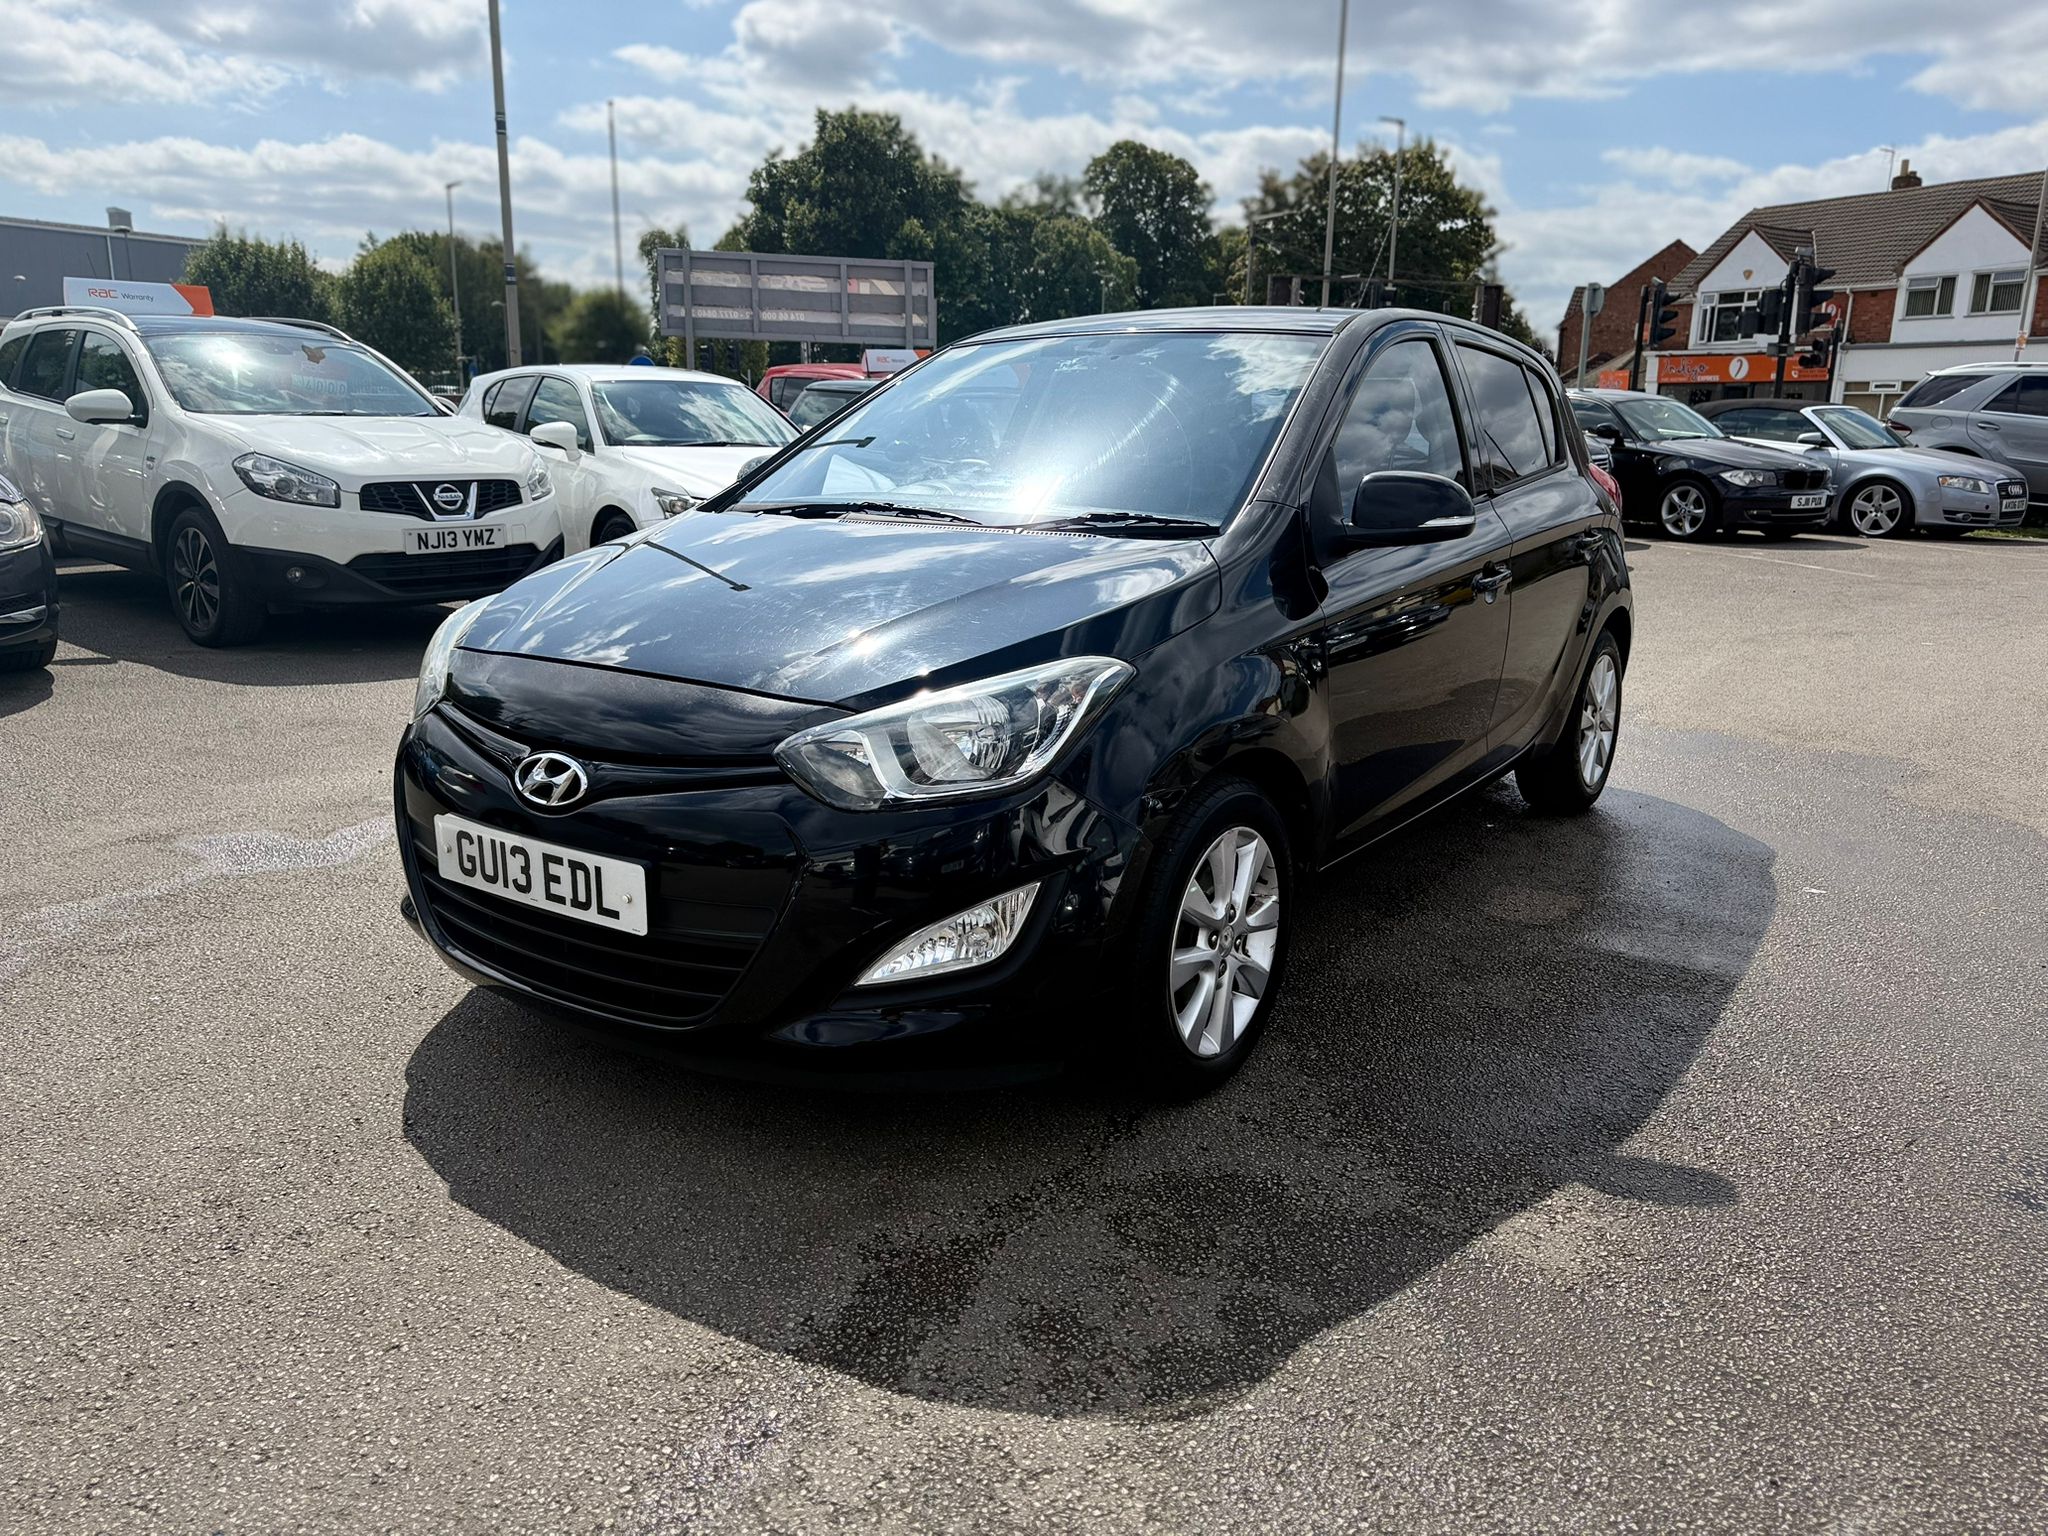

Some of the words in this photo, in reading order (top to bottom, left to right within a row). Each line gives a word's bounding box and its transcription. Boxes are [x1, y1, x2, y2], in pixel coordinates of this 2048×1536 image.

[121, 293, 154, 302] Warranty
[1662, 357, 1708, 382] Indigo
[417, 531, 458, 551] NJ13
[462, 528, 495, 547] YMZ
[456, 830, 532, 894] GU13
[542, 852, 620, 920] EDL
